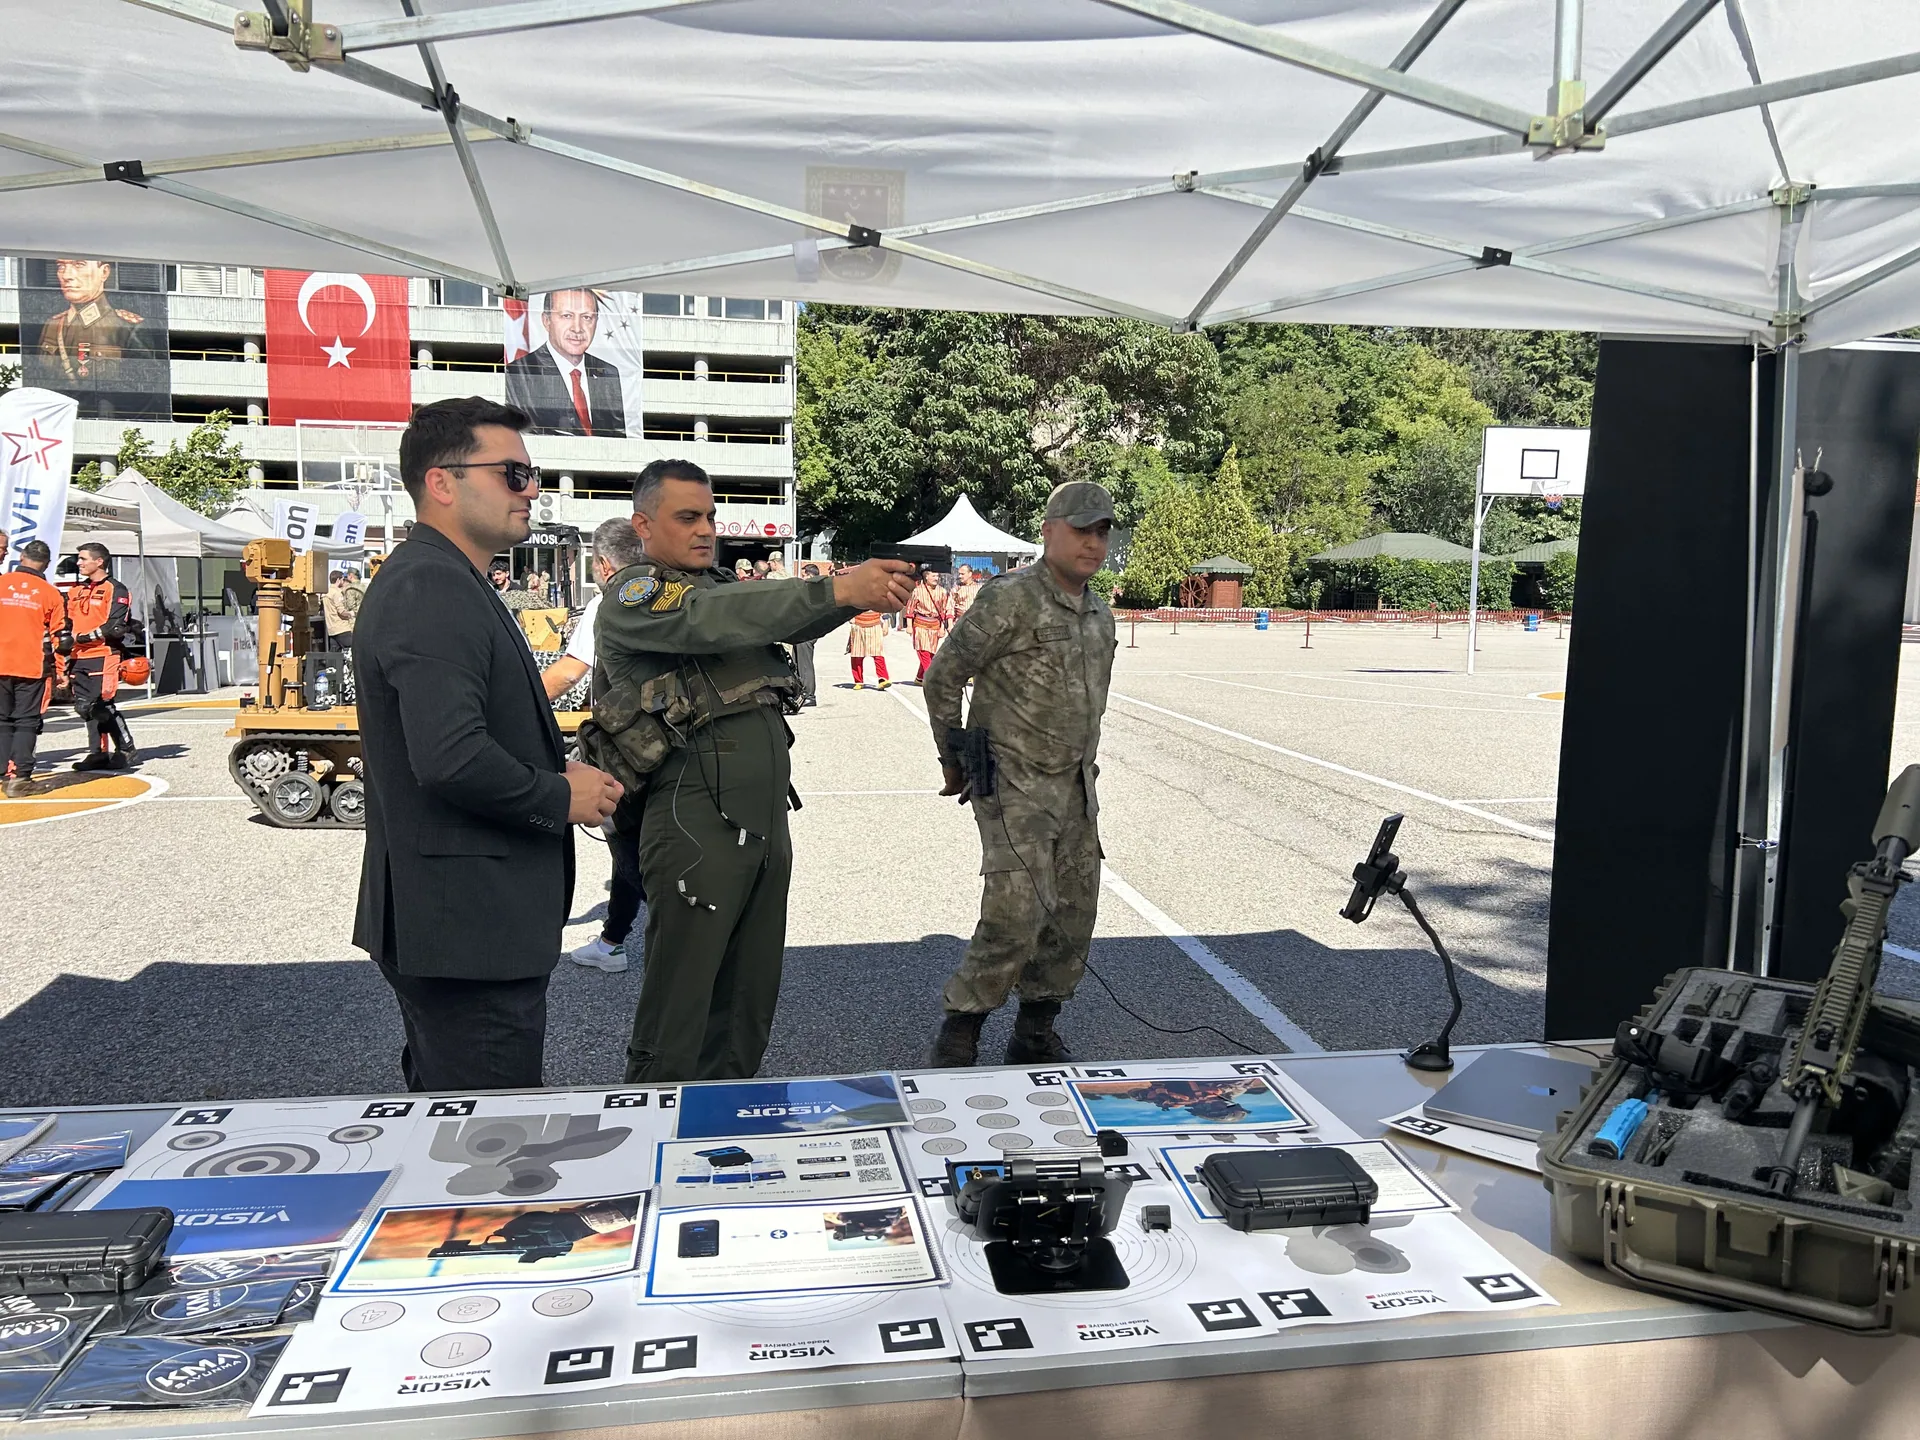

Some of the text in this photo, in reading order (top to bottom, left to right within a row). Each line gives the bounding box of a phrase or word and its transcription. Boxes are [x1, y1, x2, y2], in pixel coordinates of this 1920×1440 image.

[736, 1104, 847, 1118] VISOR
[361, 1295, 574, 1325] 2 3 4
[1369, 1294, 1448, 1310] VISOR
[0, 1321, 61, 1340] KM
[1077, 1325, 1160, 1341] VISOR
[448, 1342, 464, 1360] 1
[749, 1345, 836, 1361] VISOR
[155, 1354, 241, 1388] KMA
[175, 1361, 242, 1389] SAVUNMA
[397, 1377, 491, 1395] VISOR
